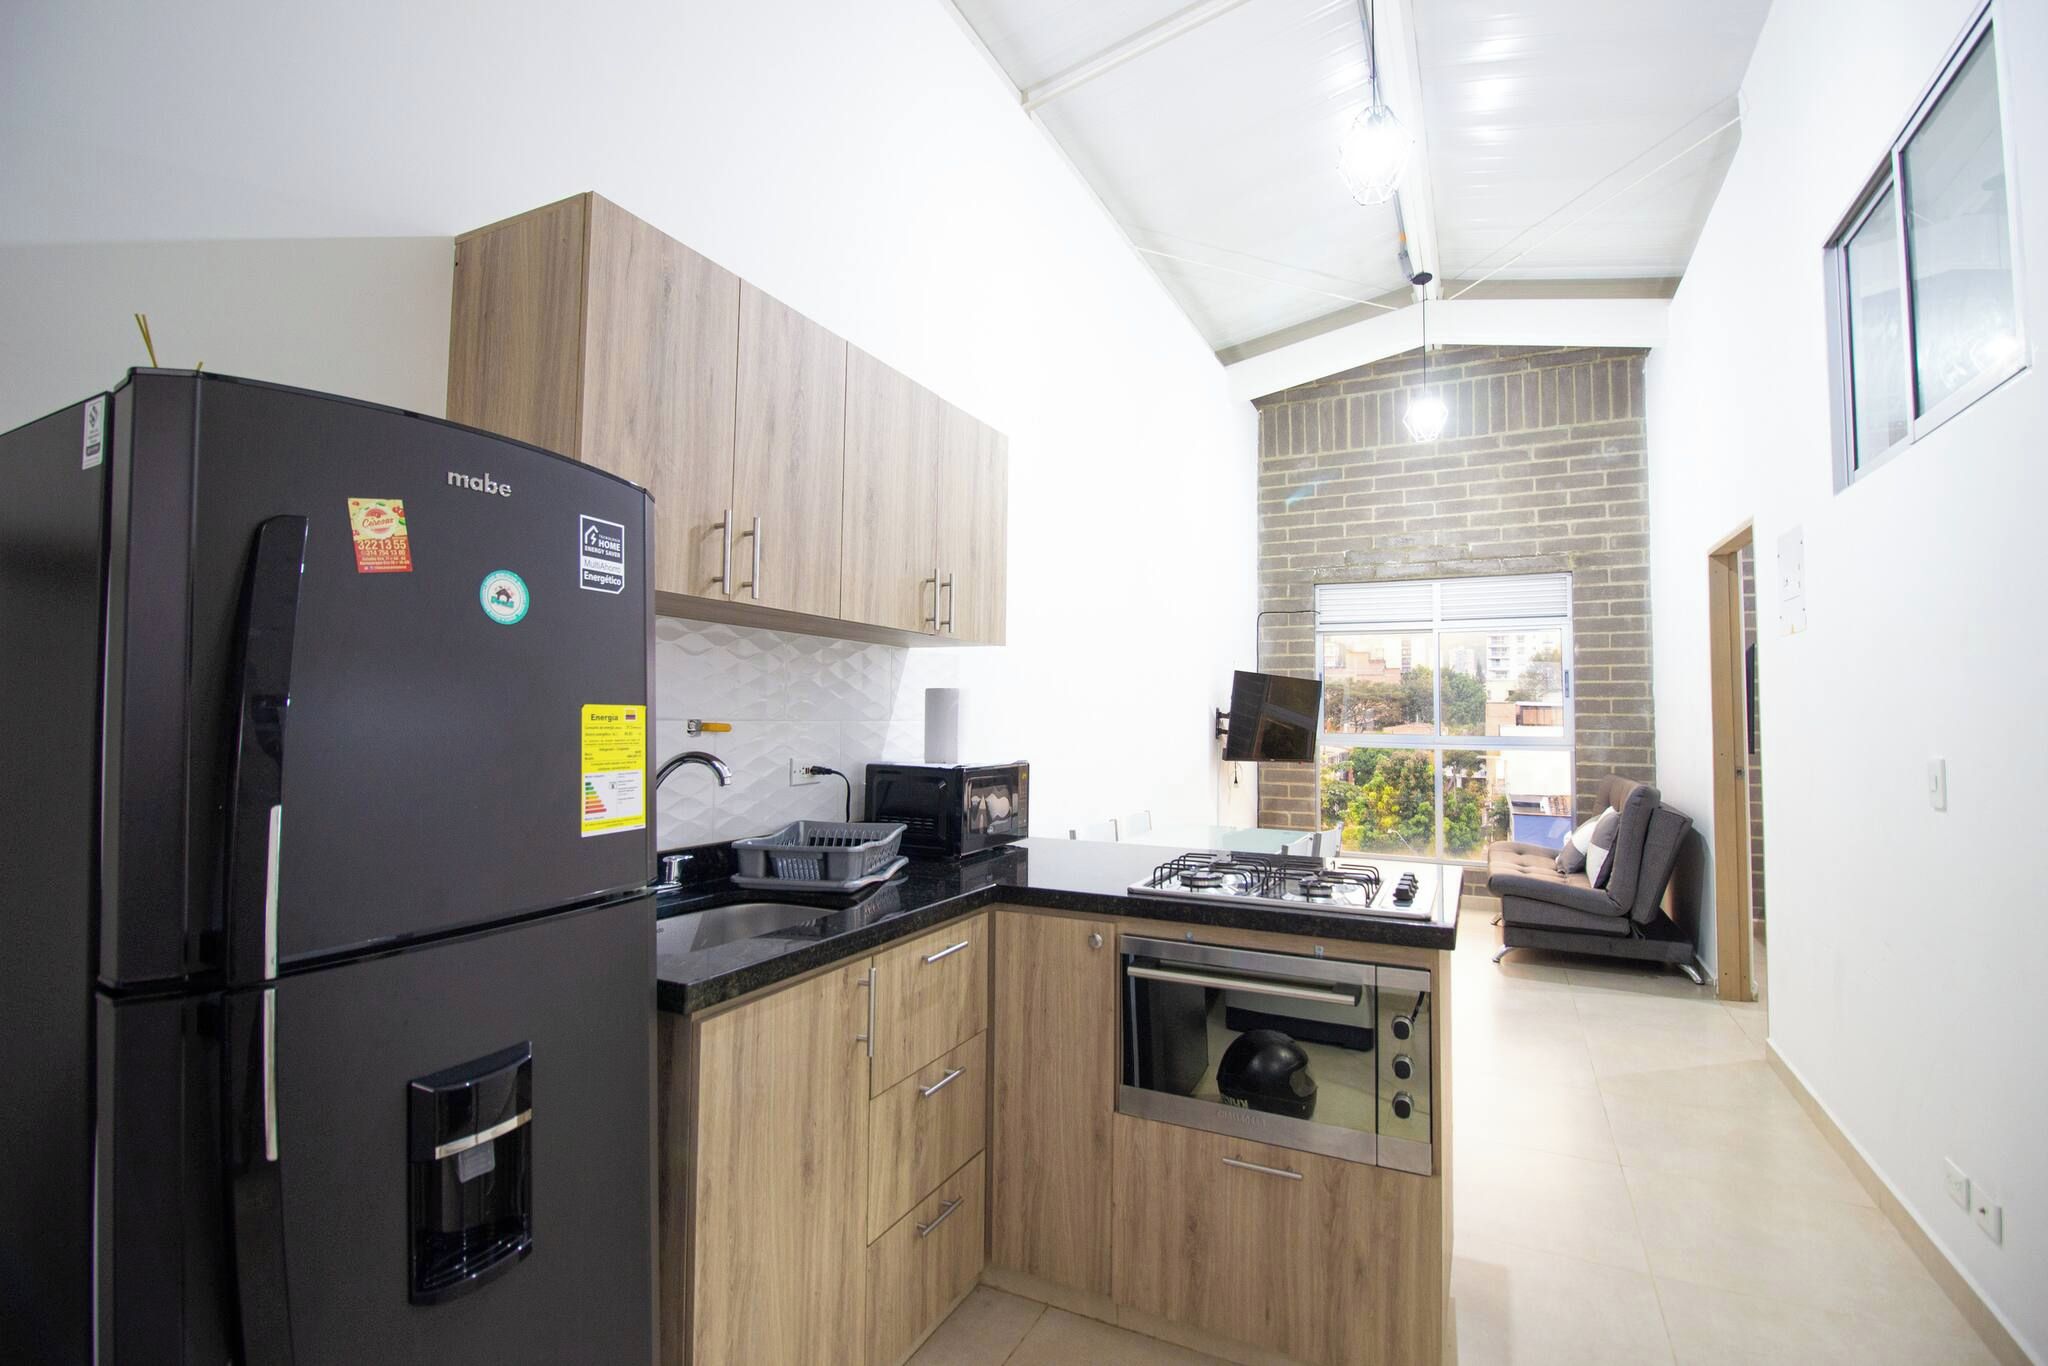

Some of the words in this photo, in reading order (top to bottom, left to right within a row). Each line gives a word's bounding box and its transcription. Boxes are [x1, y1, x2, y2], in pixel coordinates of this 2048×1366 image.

[447, 471, 512, 497] mabe
[584, 546, 605, 554] ENERGY
[598, 539, 621, 551] HOME
[583, 571, 622, 585] Energético
